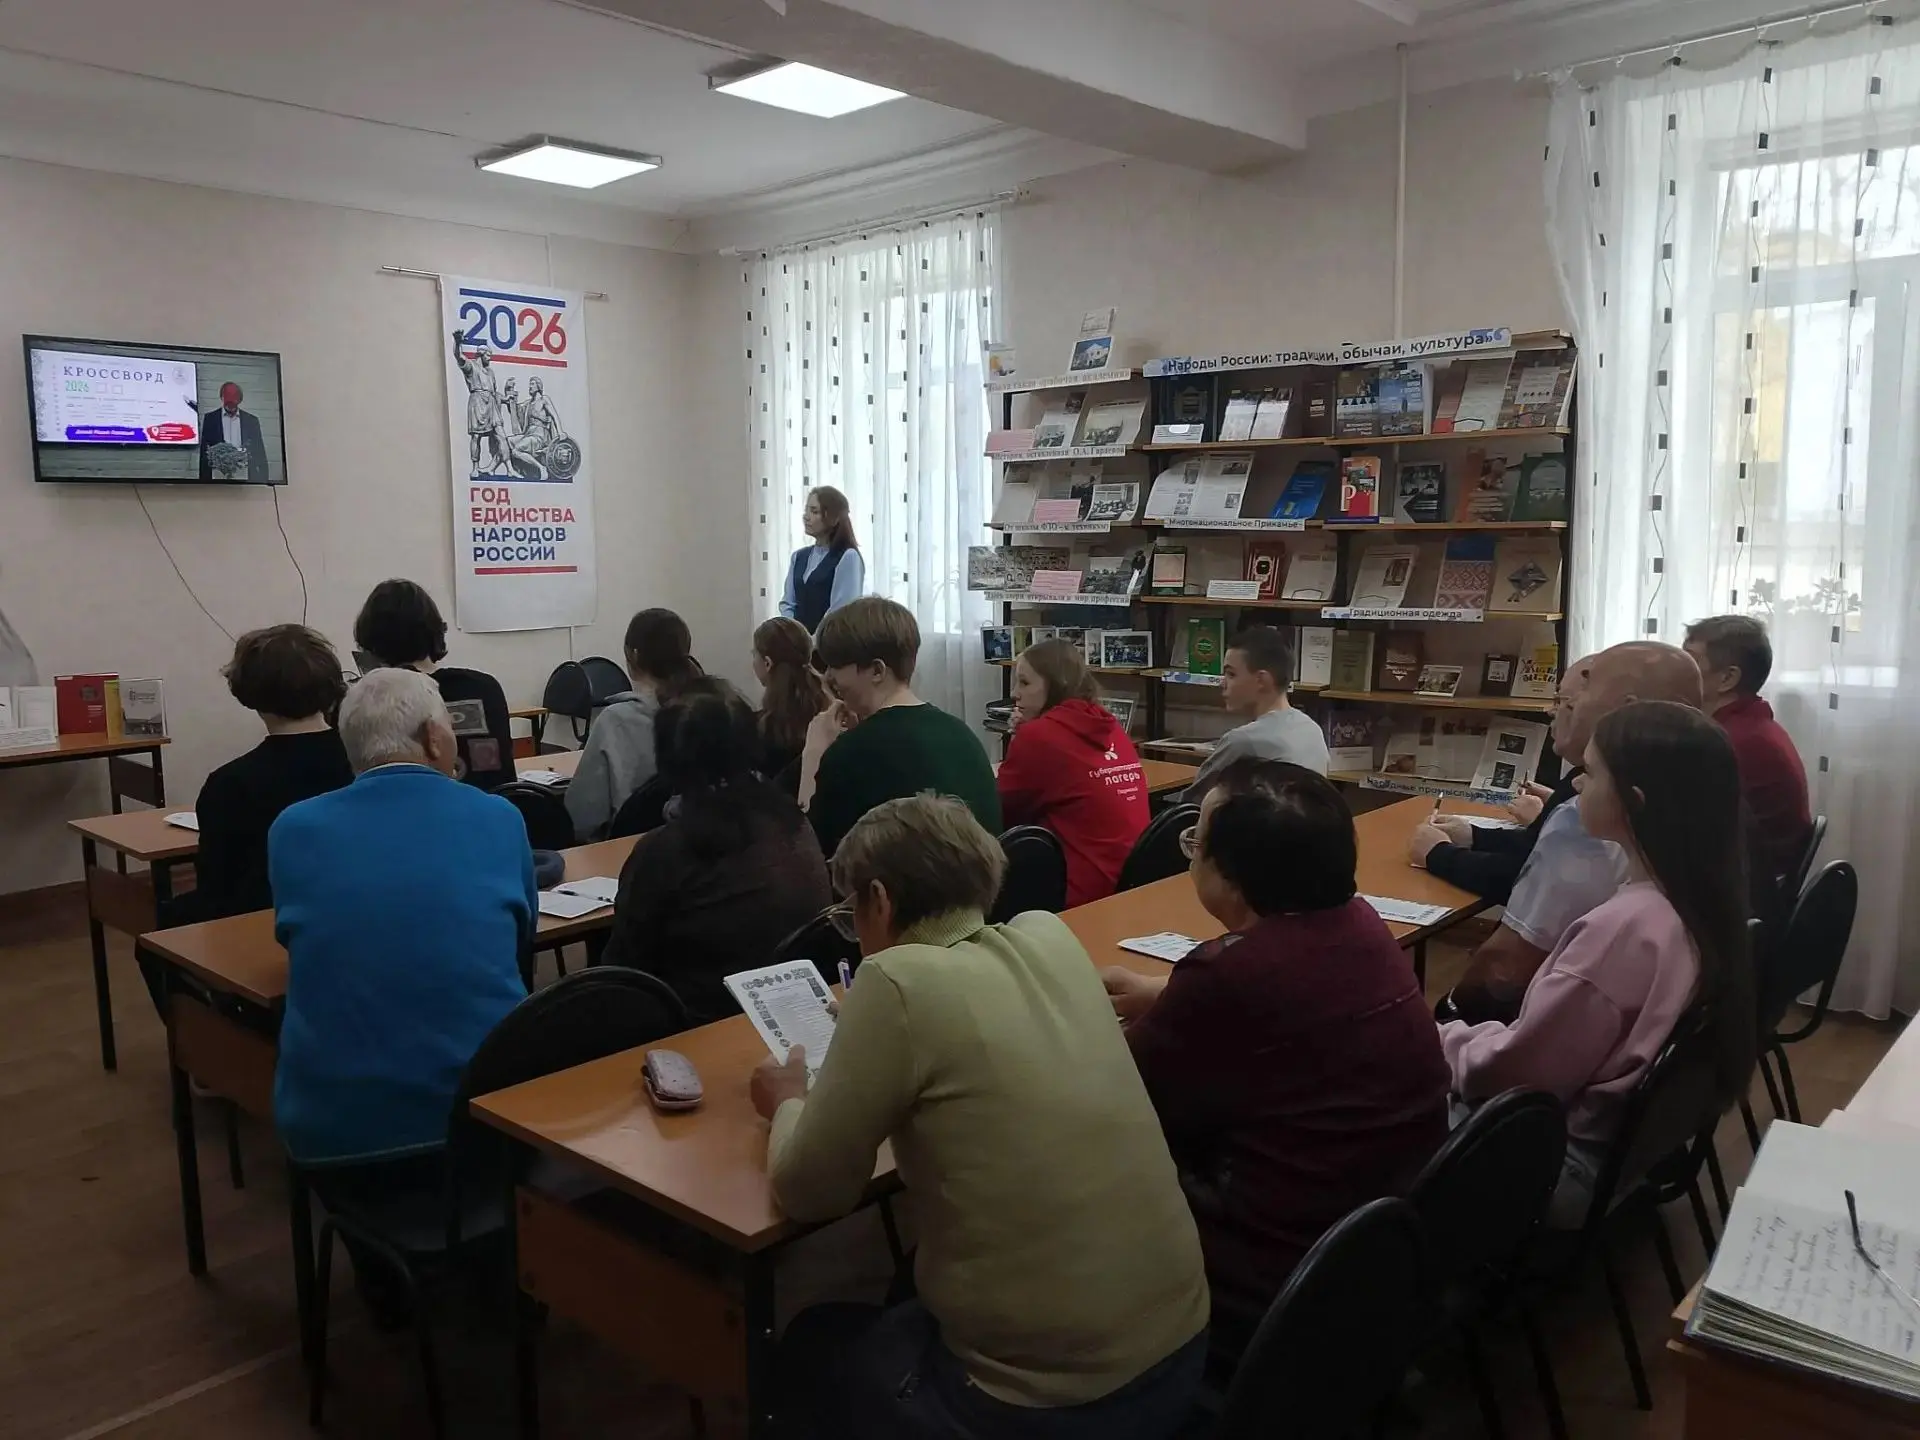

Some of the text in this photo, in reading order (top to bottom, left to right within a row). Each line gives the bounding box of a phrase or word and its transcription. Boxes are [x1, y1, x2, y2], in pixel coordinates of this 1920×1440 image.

[459, 301, 568, 355] 2026
[1221, 353, 1272, 367] России:
[1275, 350, 1339, 363] традиции,
[1410, 333, 1494, 353] культура»
[63, 366, 164, 384] КРОССВОРД
[470, 486, 511, 505] ГОД
[471, 507, 576, 524] ЕДИНСТВА
[472, 526, 567, 544] НАРОДОВ
[473, 546, 556, 563] РОССИИ
[1350, 608, 1462, 620] Традиционная одежда
